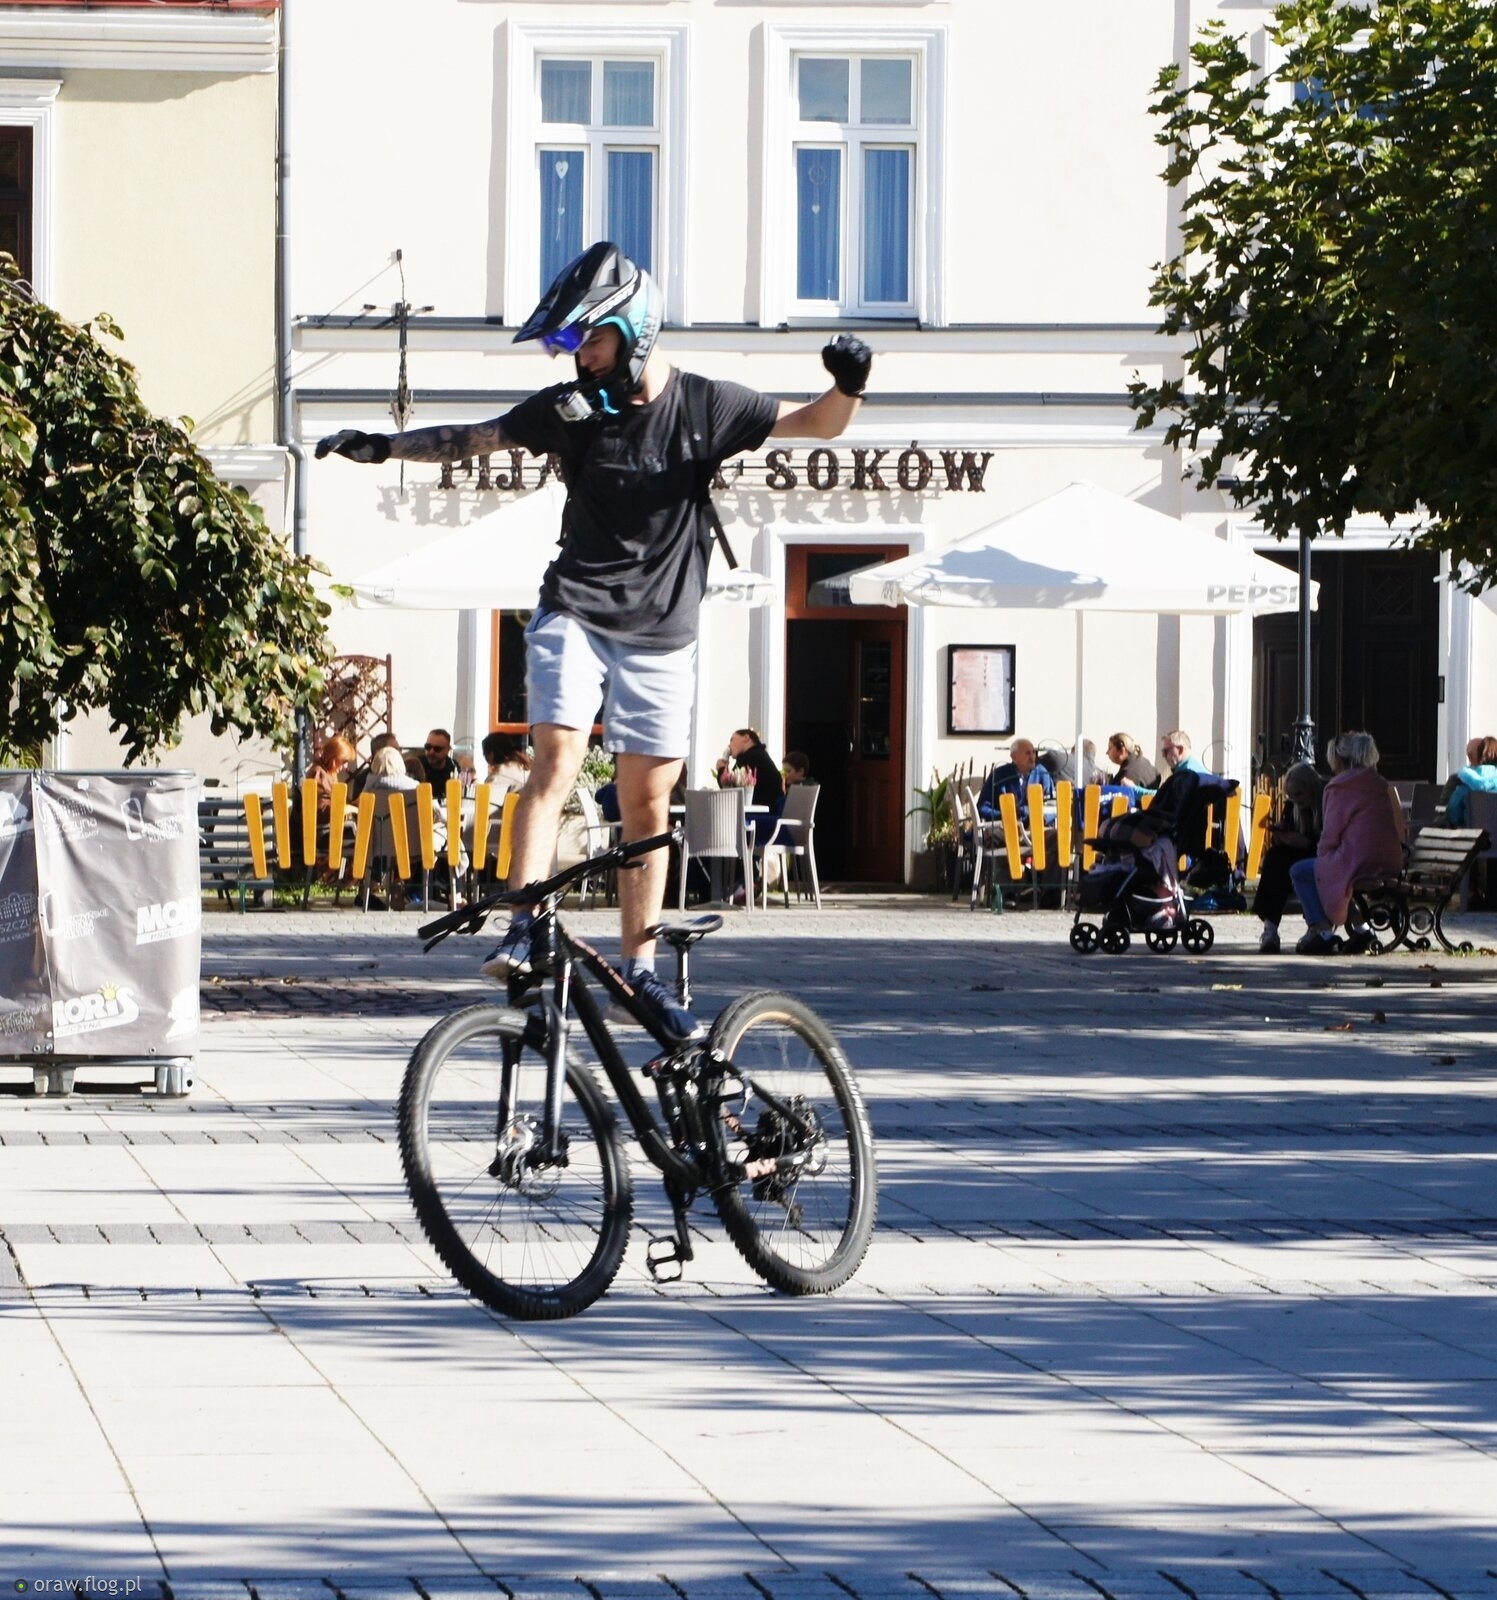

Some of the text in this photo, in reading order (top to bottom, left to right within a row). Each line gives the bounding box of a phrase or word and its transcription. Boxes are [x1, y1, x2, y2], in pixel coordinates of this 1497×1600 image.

[765, 440, 995, 492] SOKÓW
[704, 583, 756, 602] PSI
[1206, 584, 1299, 604] PEPSI
